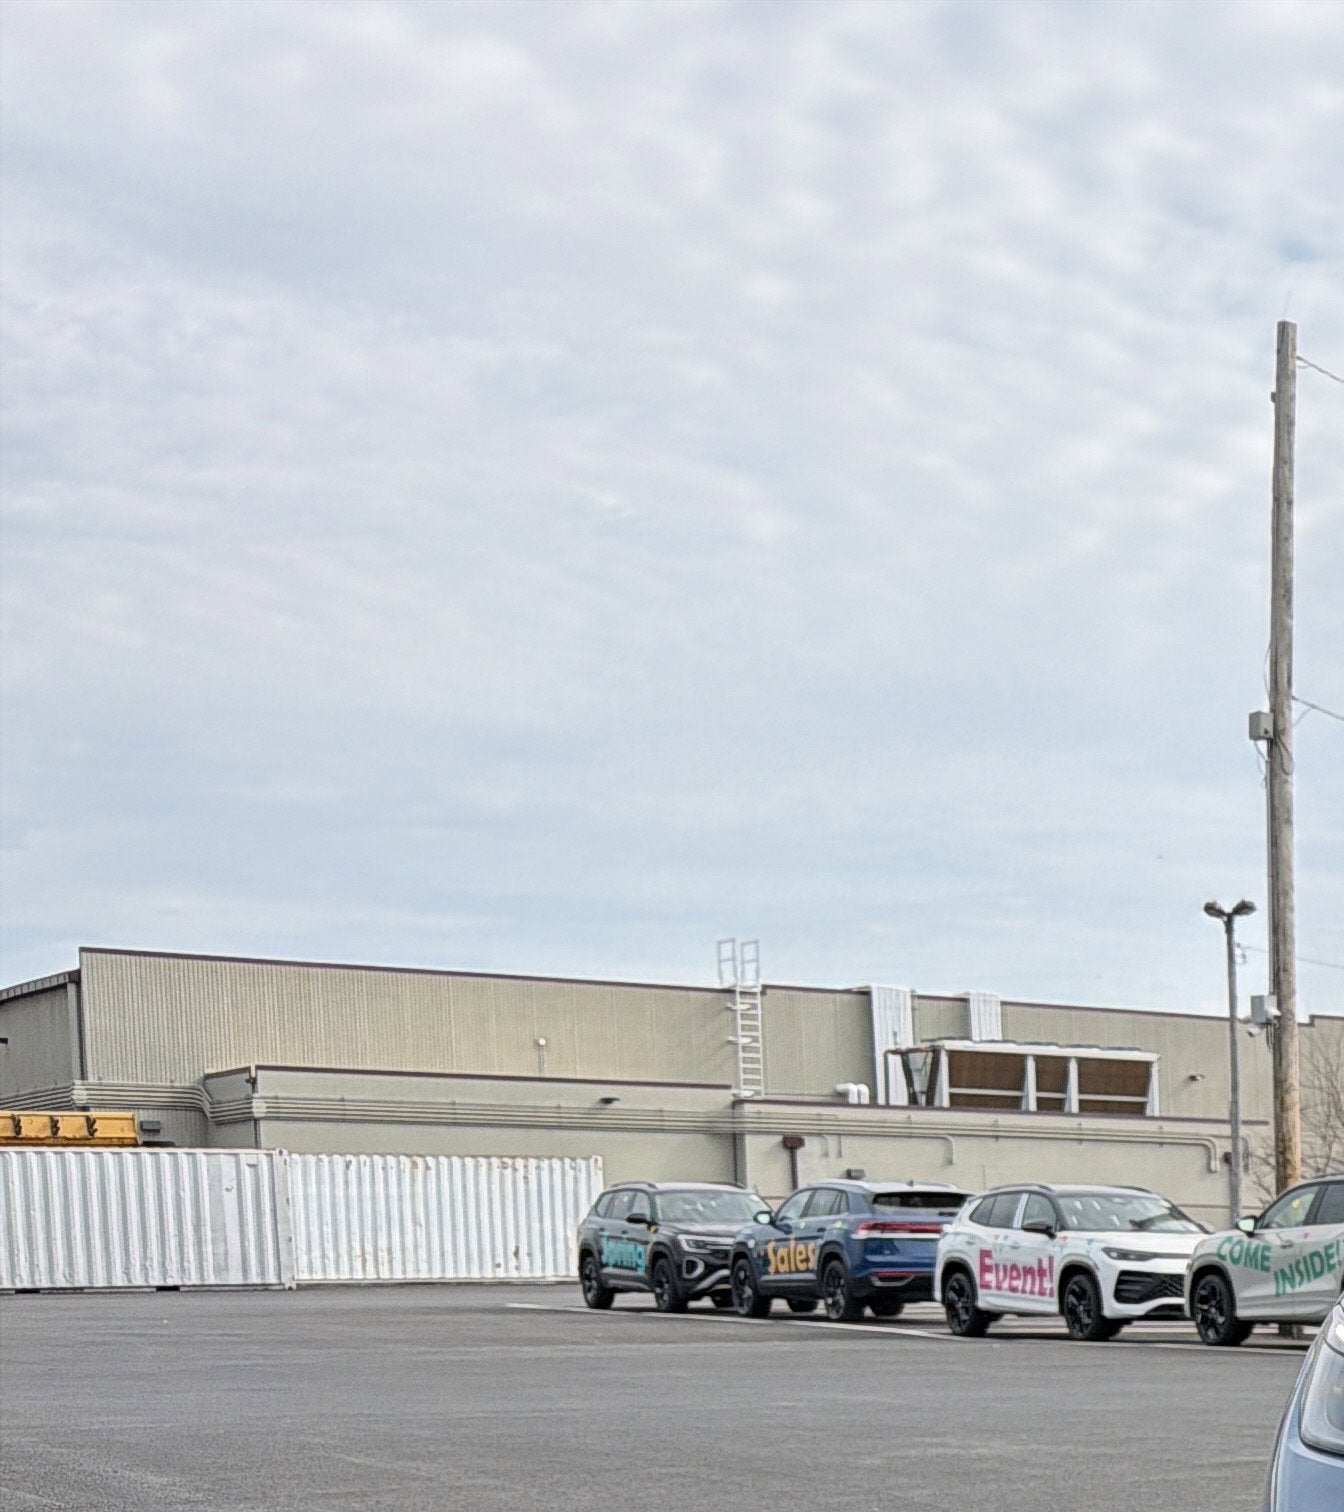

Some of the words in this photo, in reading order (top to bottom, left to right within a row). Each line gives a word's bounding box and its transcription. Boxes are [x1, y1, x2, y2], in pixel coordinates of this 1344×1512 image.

[979, 1248, 1055, 1298] Event!
[1216, 1236, 1272, 1273] COME
[1273, 1239, 1343, 1297] INSIDE!
